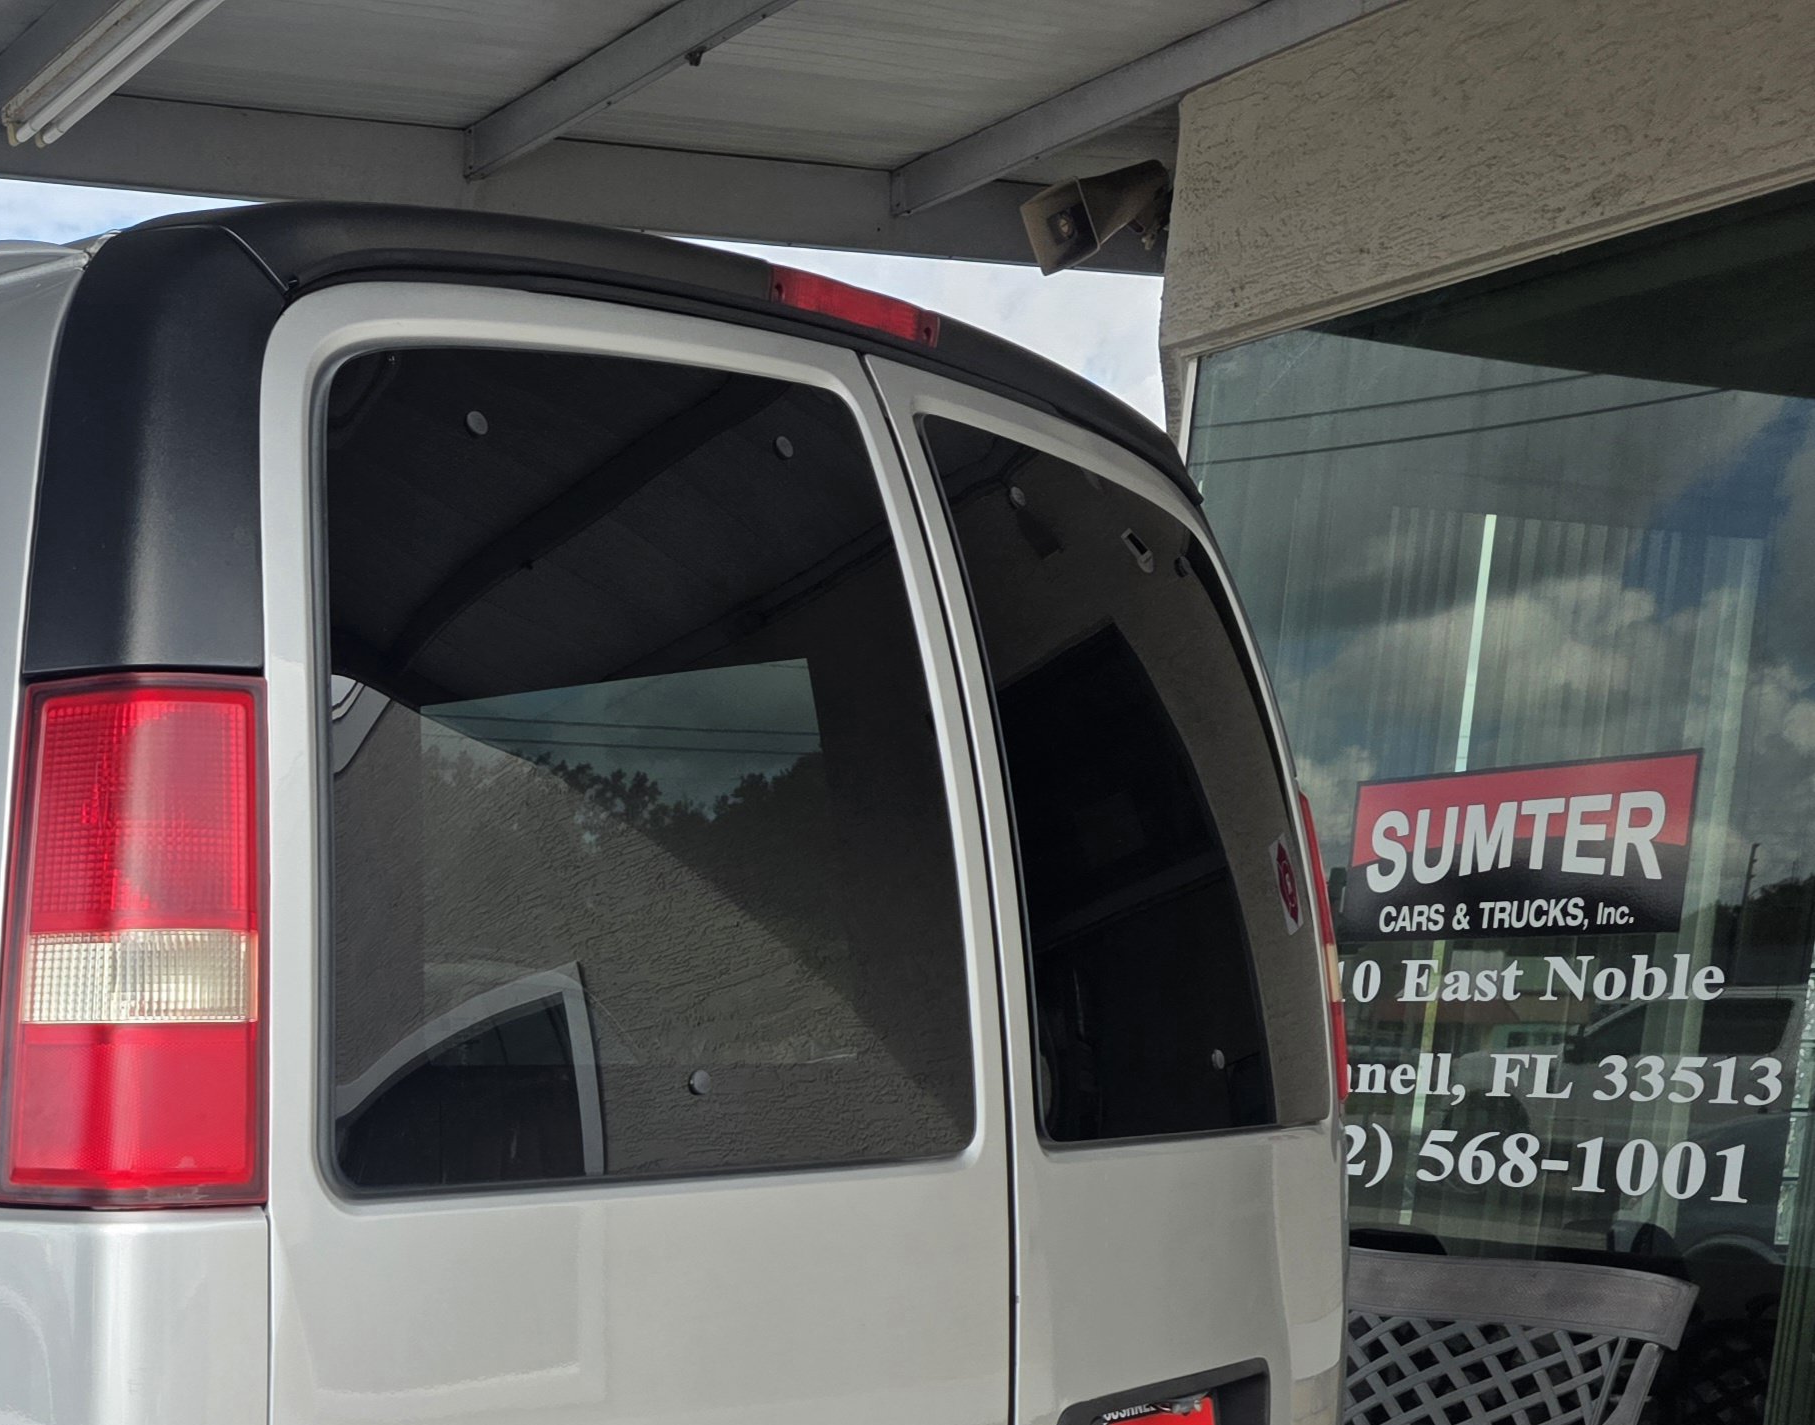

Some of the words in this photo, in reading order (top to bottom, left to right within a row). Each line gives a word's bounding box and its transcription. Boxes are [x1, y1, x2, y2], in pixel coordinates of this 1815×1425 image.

[1365, 789, 1667, 894] SUMTER
[1378, 902, 1445, 934] CARS
[1451, 904, 1470, 931] &
[1479, 897, 1589, 932] TRUCKS,
[1596, 901, 1635, 926] Inc.
[1397, 957, 1524, 1004] East
[1540, 954, 1725, 1002] Noble
[1485, 1054, 1573, 1099] FL
[1593, 1054, 1784, 1107] 33513
[1416, 1129, 1749, 1205] 568-1001
